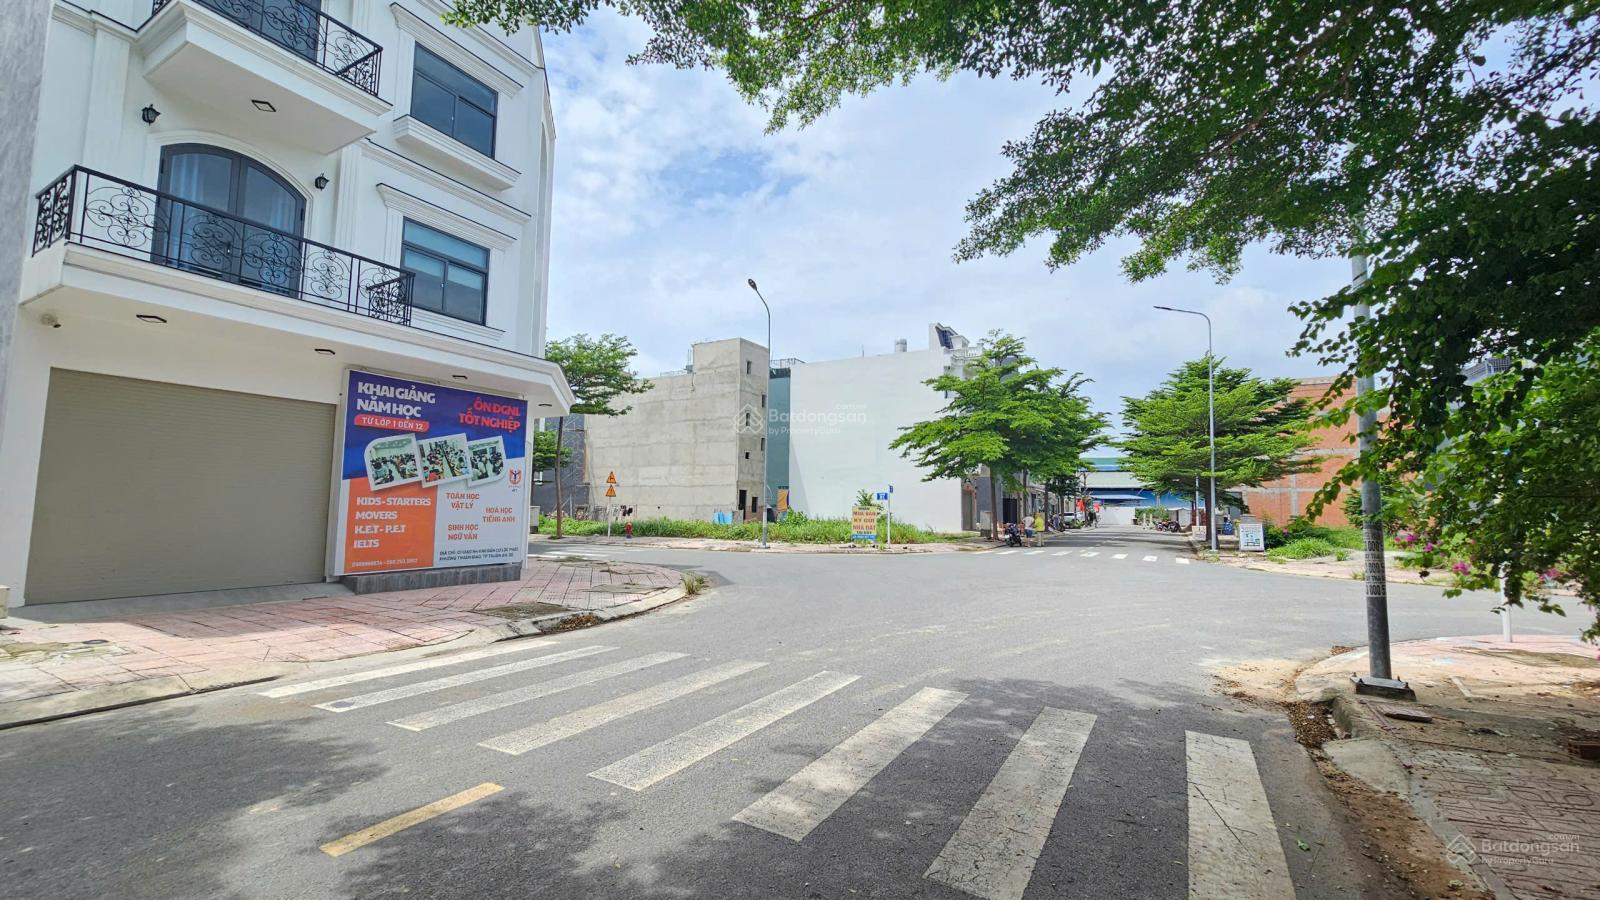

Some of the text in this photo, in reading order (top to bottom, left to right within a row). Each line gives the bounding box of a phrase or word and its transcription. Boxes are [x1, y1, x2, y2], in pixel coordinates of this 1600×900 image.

[358, 382, 436, 404] KHAI GIẢNG
[356, 396, 422, 420] NĂM HỌC
[474, 396, 491, 412] ÔN
[458, 408, 520, 432] TỐT NGHIỆP
[356, 496, 381, 506] KIDS
[386, 497, 432, 506] STARTERS
[446, 492, 480, 501] TOÁN HỌC
[451, 501, 464, 510] VẬT
[356, 511, 398, 520] MOVERS
[465, 524, 479, 533] HỌC
[448, 532, 462, 540] NGỮ
[354, 539, 379, 548] IELTS
